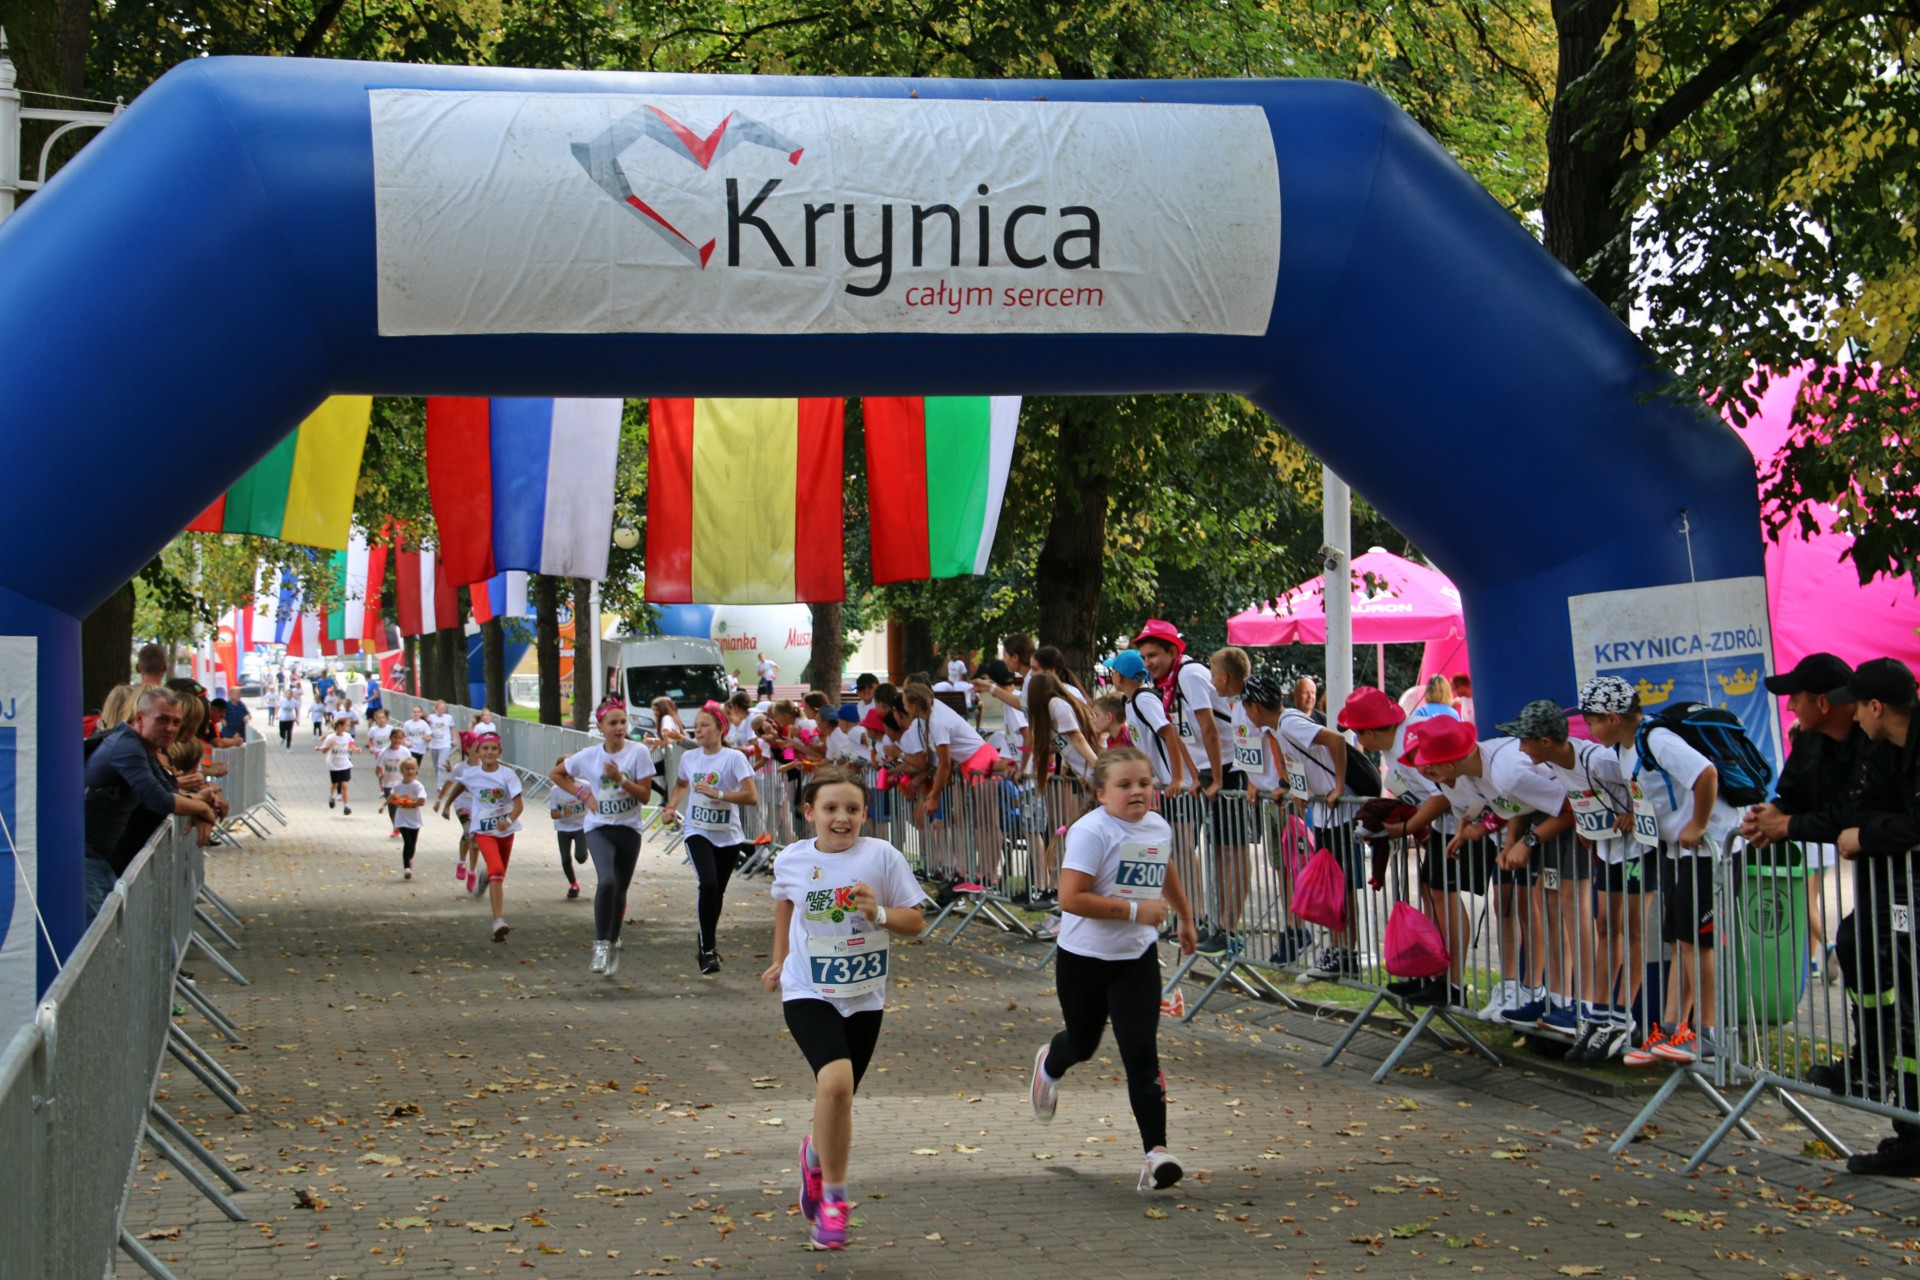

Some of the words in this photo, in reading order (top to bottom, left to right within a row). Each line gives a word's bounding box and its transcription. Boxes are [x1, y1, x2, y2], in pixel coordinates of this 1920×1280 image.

[726, 178, 1101, 297] Krynica
[906, 279, 993, 314] całym
[1003, 287, 1104, 307] sercem
[1350, 603, 1413, 613] AURON
[784, 627, 812, 652] Musz
[1594, 623, 1763, 664] KRYNICA-ZDRÓJ
[602, 797, 635, 815] 8000
[694, 807, 727, 823] 8001
[1634, 816, 1656, 835] 16
[1122, 862, 1166, 886] 7300
[806, 889, 833, 902] RUSZ
[816, 952, 882, 983] 7323
